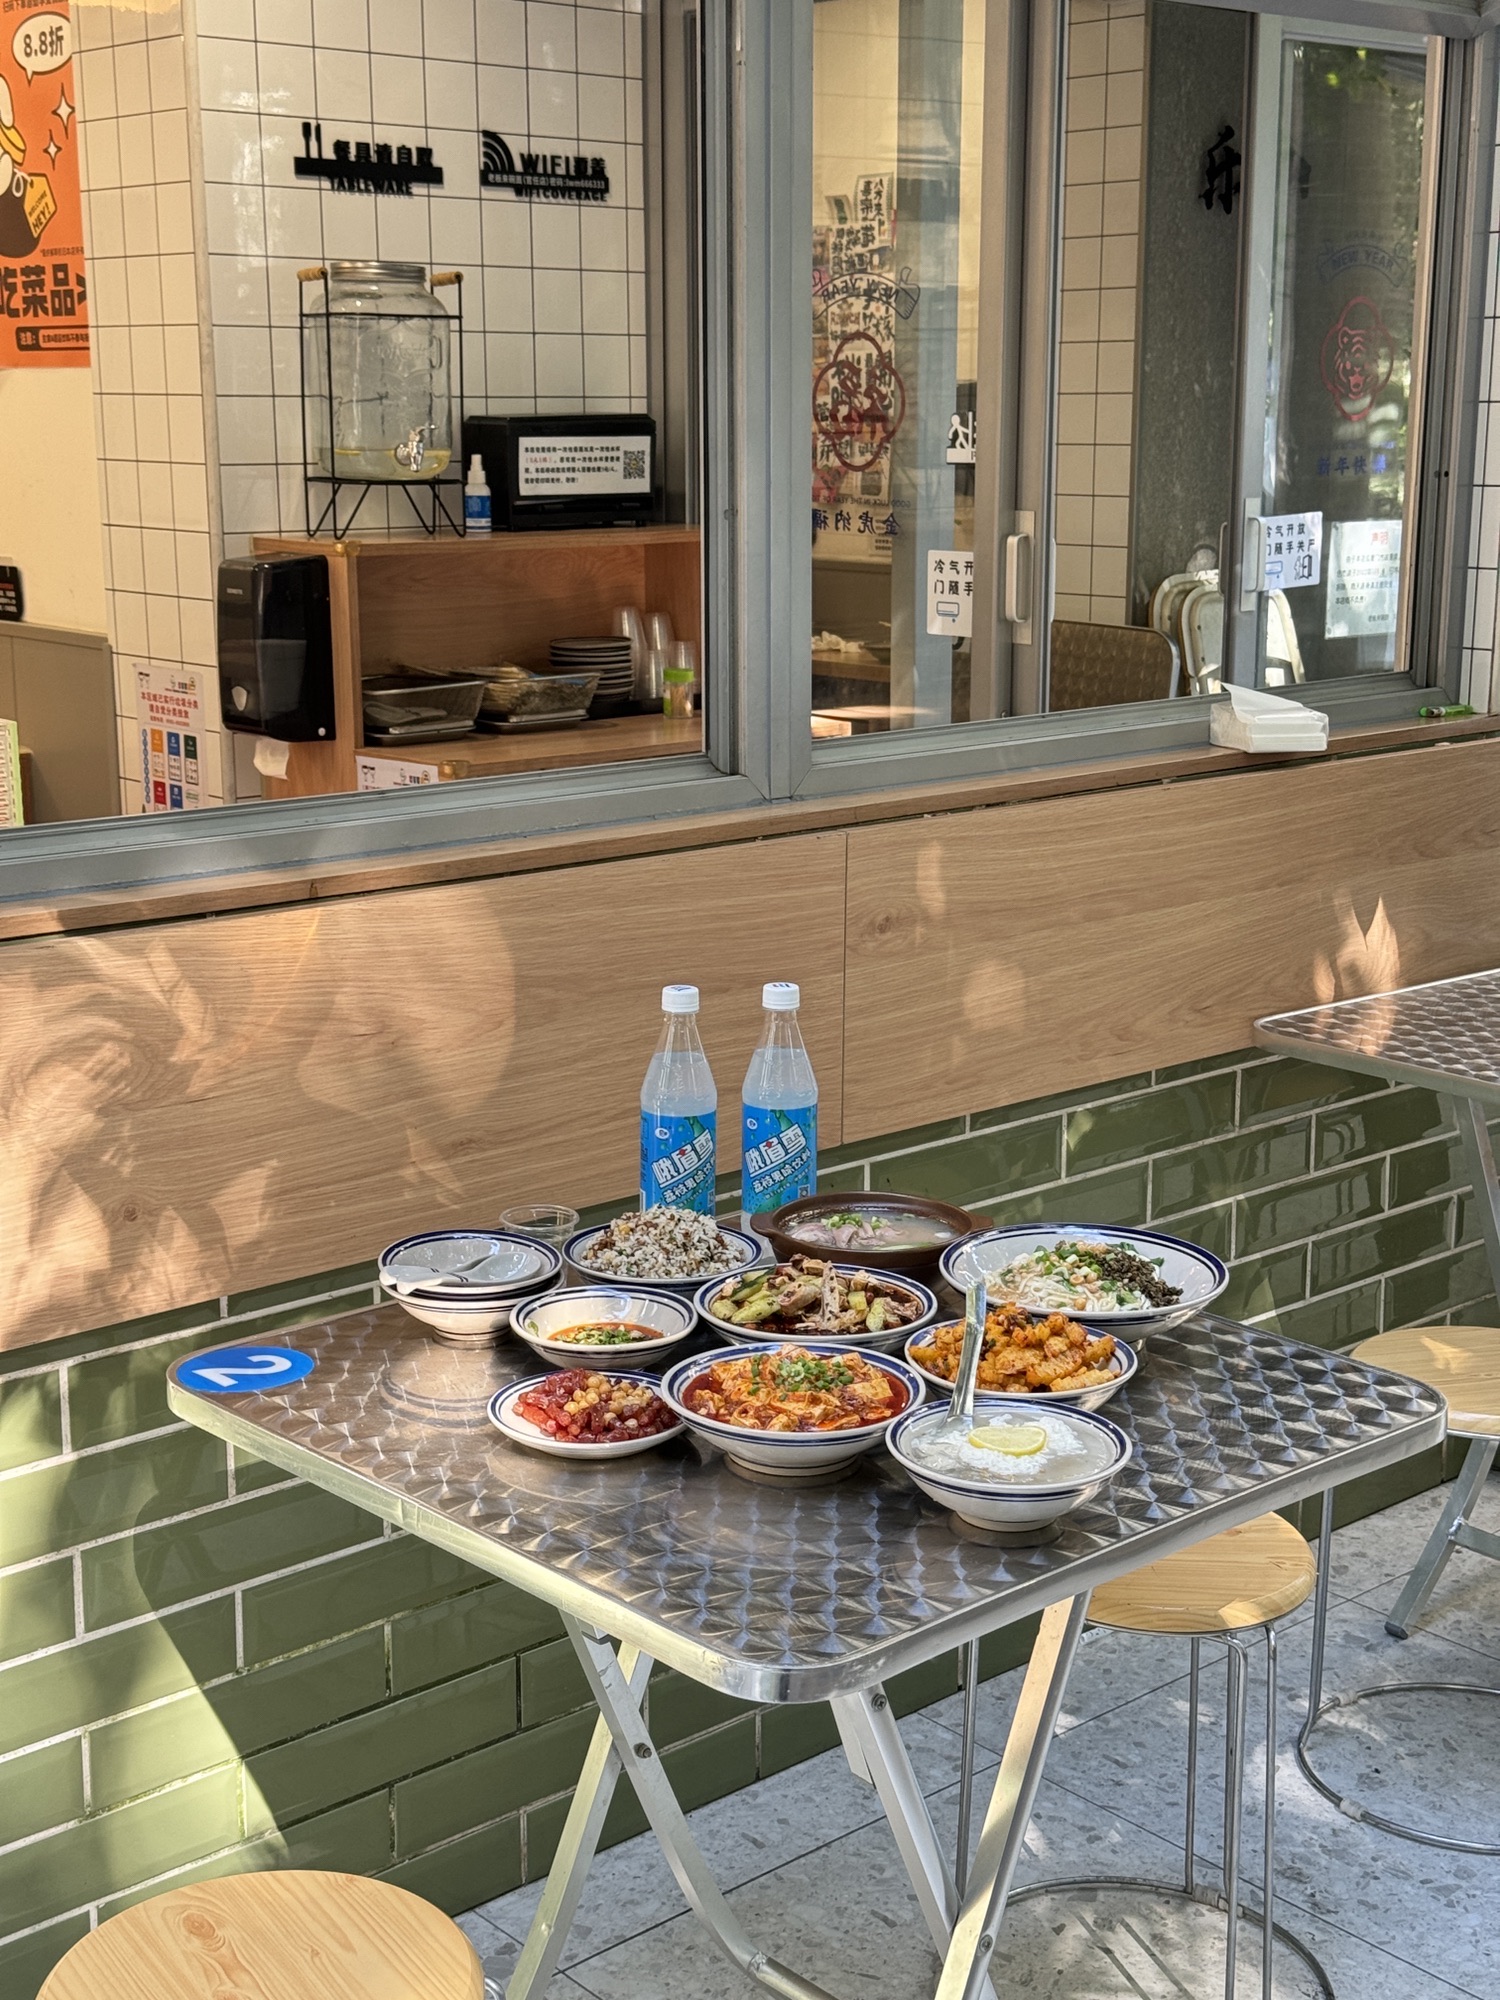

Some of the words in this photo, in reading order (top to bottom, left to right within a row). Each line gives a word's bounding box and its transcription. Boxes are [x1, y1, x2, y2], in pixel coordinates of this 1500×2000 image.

[23, 25, 65, 58] 8.8折
[332, 139, 433, 167] 餐具请自取
[330, 176, 413, 196] TABLEWARE
[542, 189, 608, 202] COVERAGE
[32, 202, 51, 233] HEY!
[933, 558, 974, 576] 冷气开
[933, 579, 974, 597] 门随手
[651, 1128, 714, 1184] 峨眉雪
[745, 1123, 807, 1174] 峨眉雪
[191, 1354, 293, 1388] 2
